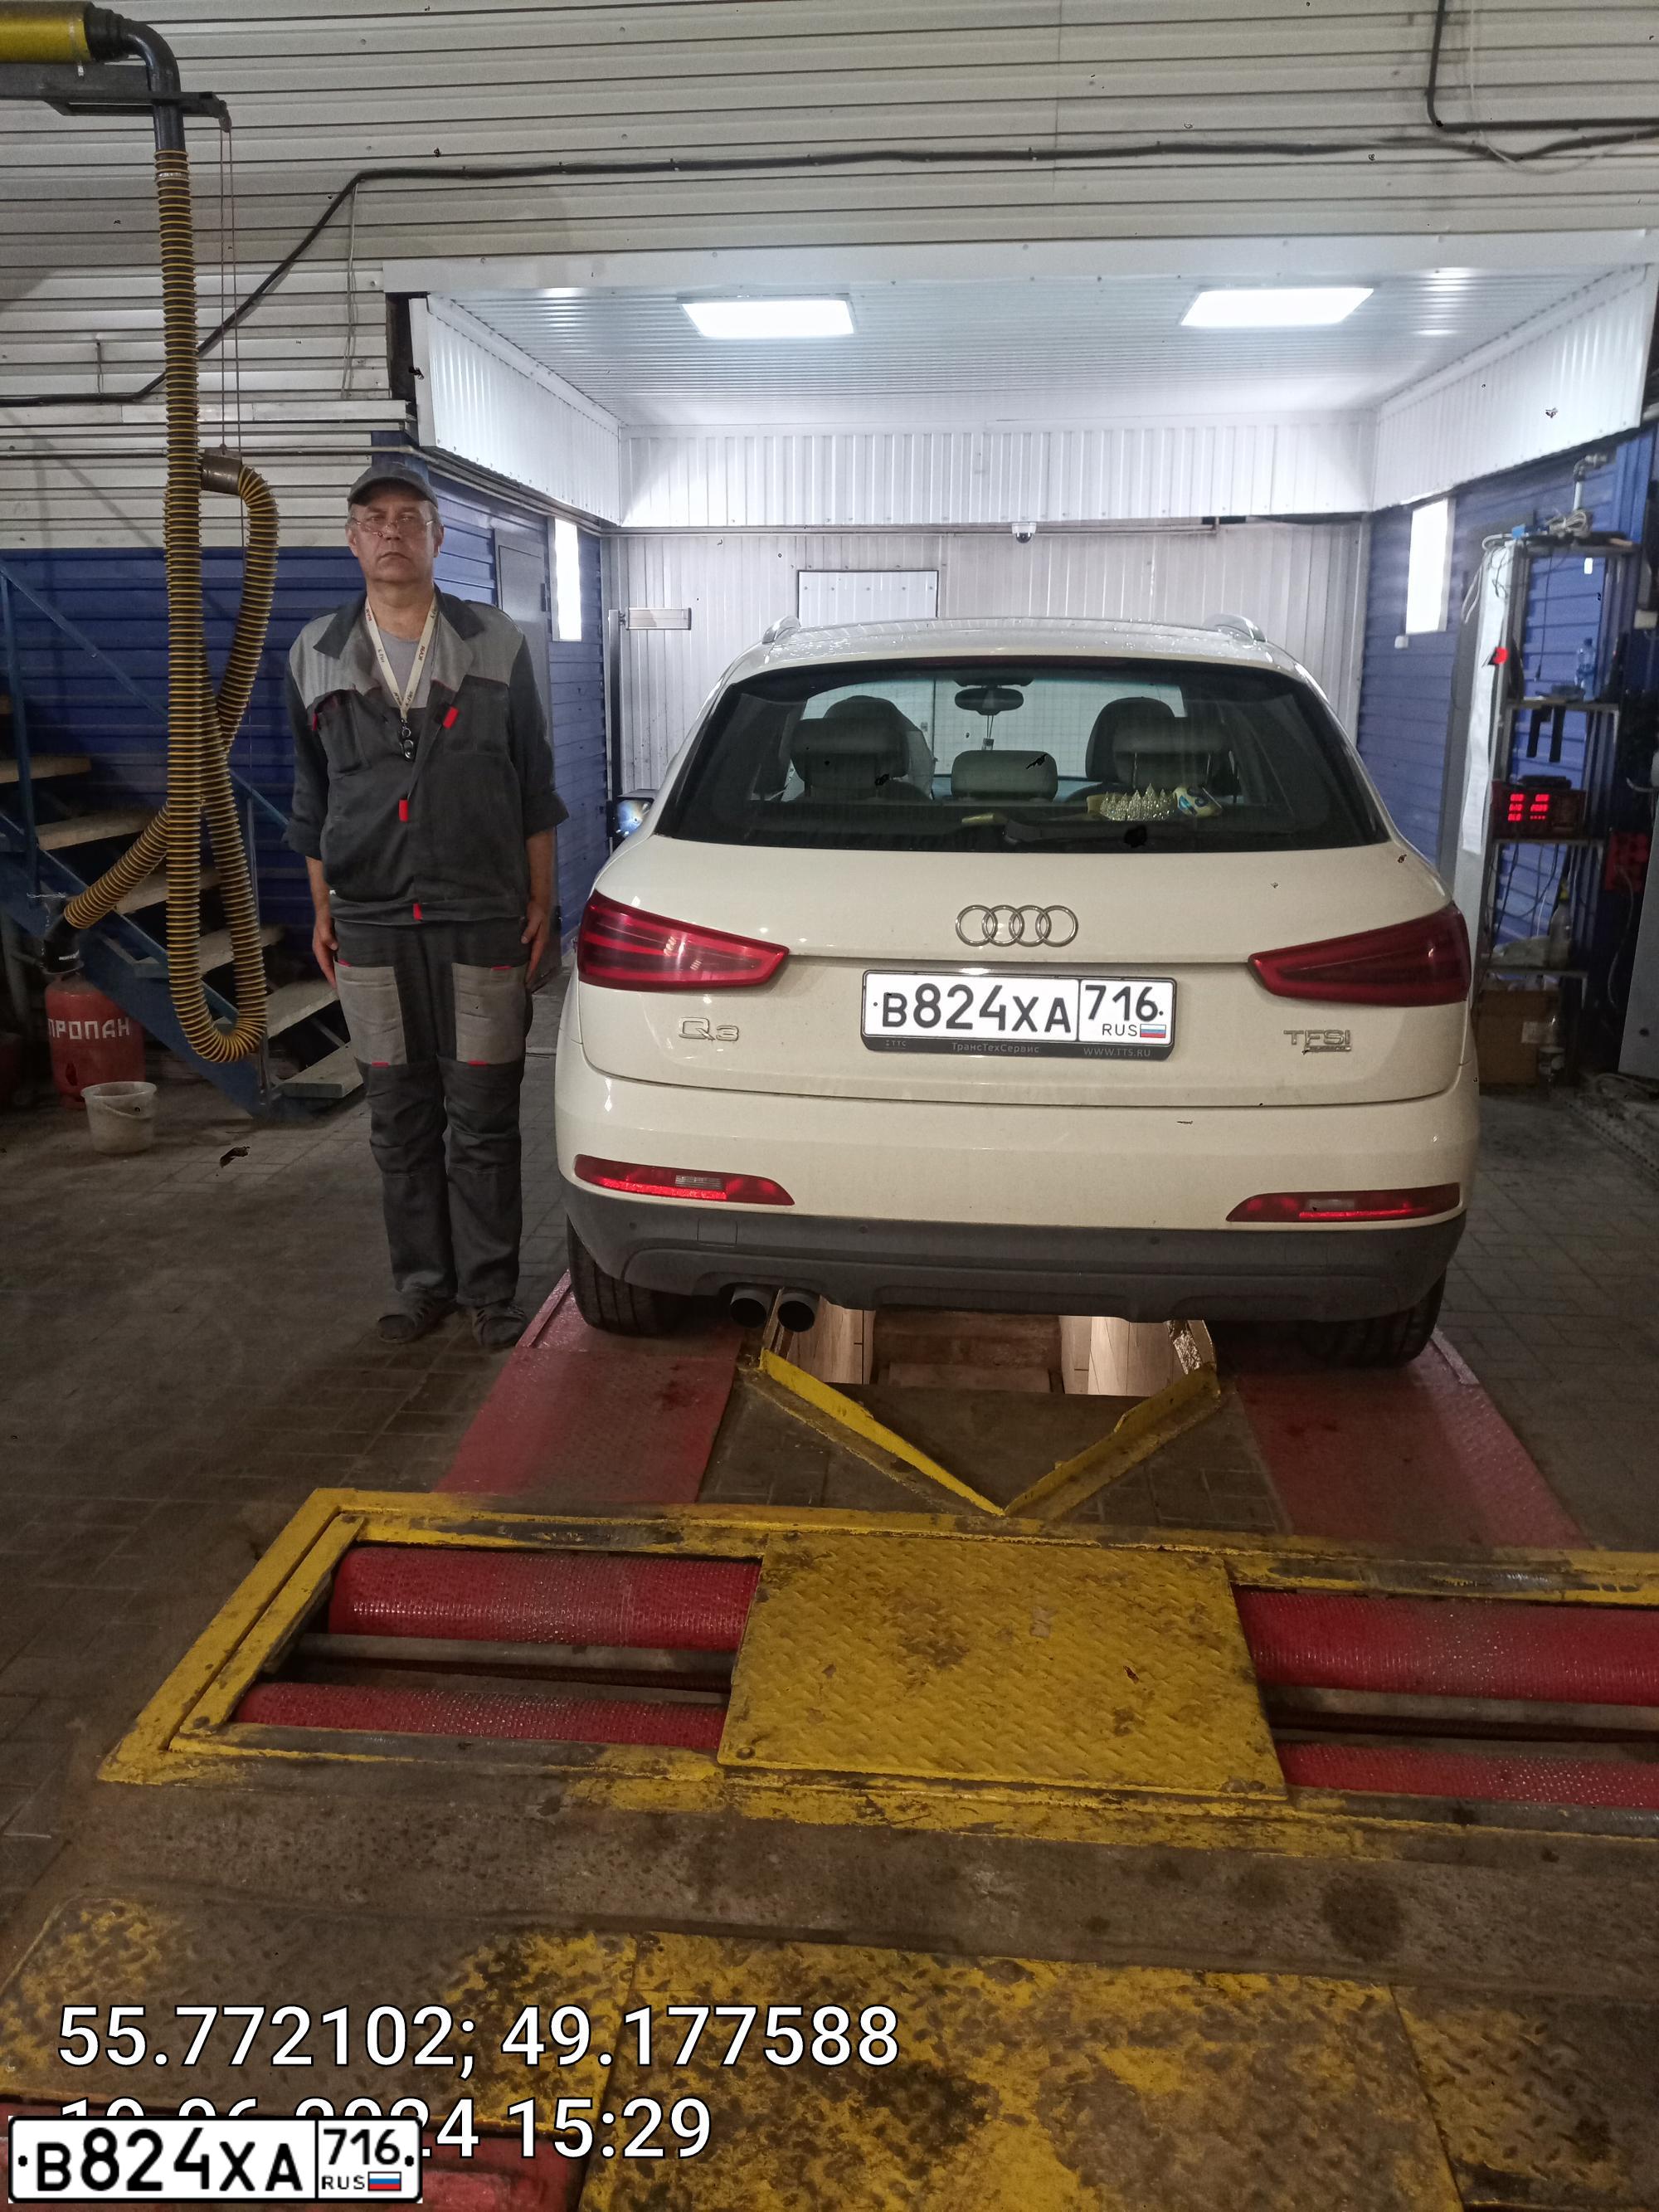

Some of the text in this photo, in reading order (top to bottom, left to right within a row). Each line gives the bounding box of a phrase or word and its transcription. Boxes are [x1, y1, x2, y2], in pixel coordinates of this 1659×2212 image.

[1085, 984, 1159, 1022] 716
[47, 1017, 130, 1040] ПРОПАН
[679, 1017, 740, 1041] Q3
[1102, 1023, 1138, 1037] RUS
[1282, 1029, 1350, 1045] TFSI
[951, 1042, 1039, 1054] ТрансТехСервис
